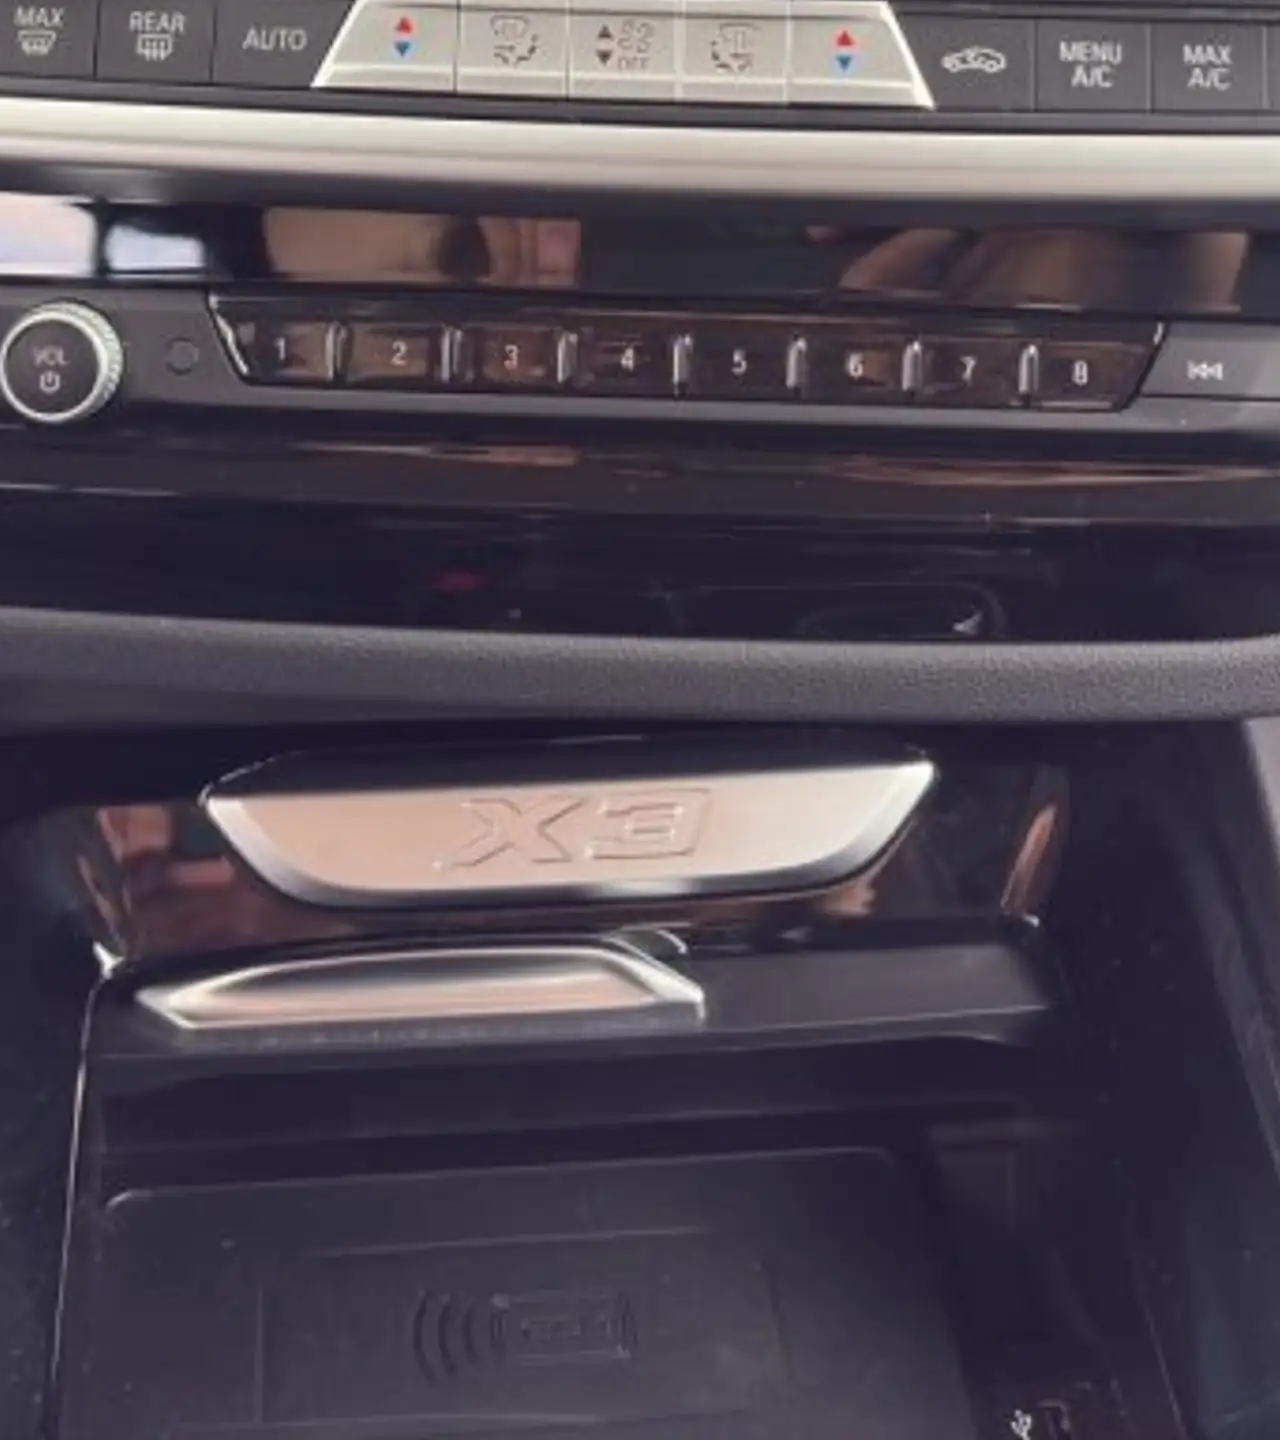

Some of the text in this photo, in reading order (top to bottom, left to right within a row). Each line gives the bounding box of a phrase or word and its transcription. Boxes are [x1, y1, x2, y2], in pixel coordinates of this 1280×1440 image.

[15, 6, 65, 28] MAX
[129, 10, 187, 34] REAR
[242, 26, 308, 52] AUTO
[1059, 40, 1122, 65] MENU
[1183, 44, 1233, 66] MAX
[1070, 64, 1114, 89] A/C
[1186, 67, 1233, 91] A/C
[391, 340, 409, 366] 2
[503, 344, 520, 370] 3
[620, 347, 635, 371] 4
[731, 348, 748, 375] 5
[848, 352, 865, 379] 6
[960, 356, 977, 381] 7
[1072, 360, 1089, 386] 8
[432, 786, 713, 871] X3
